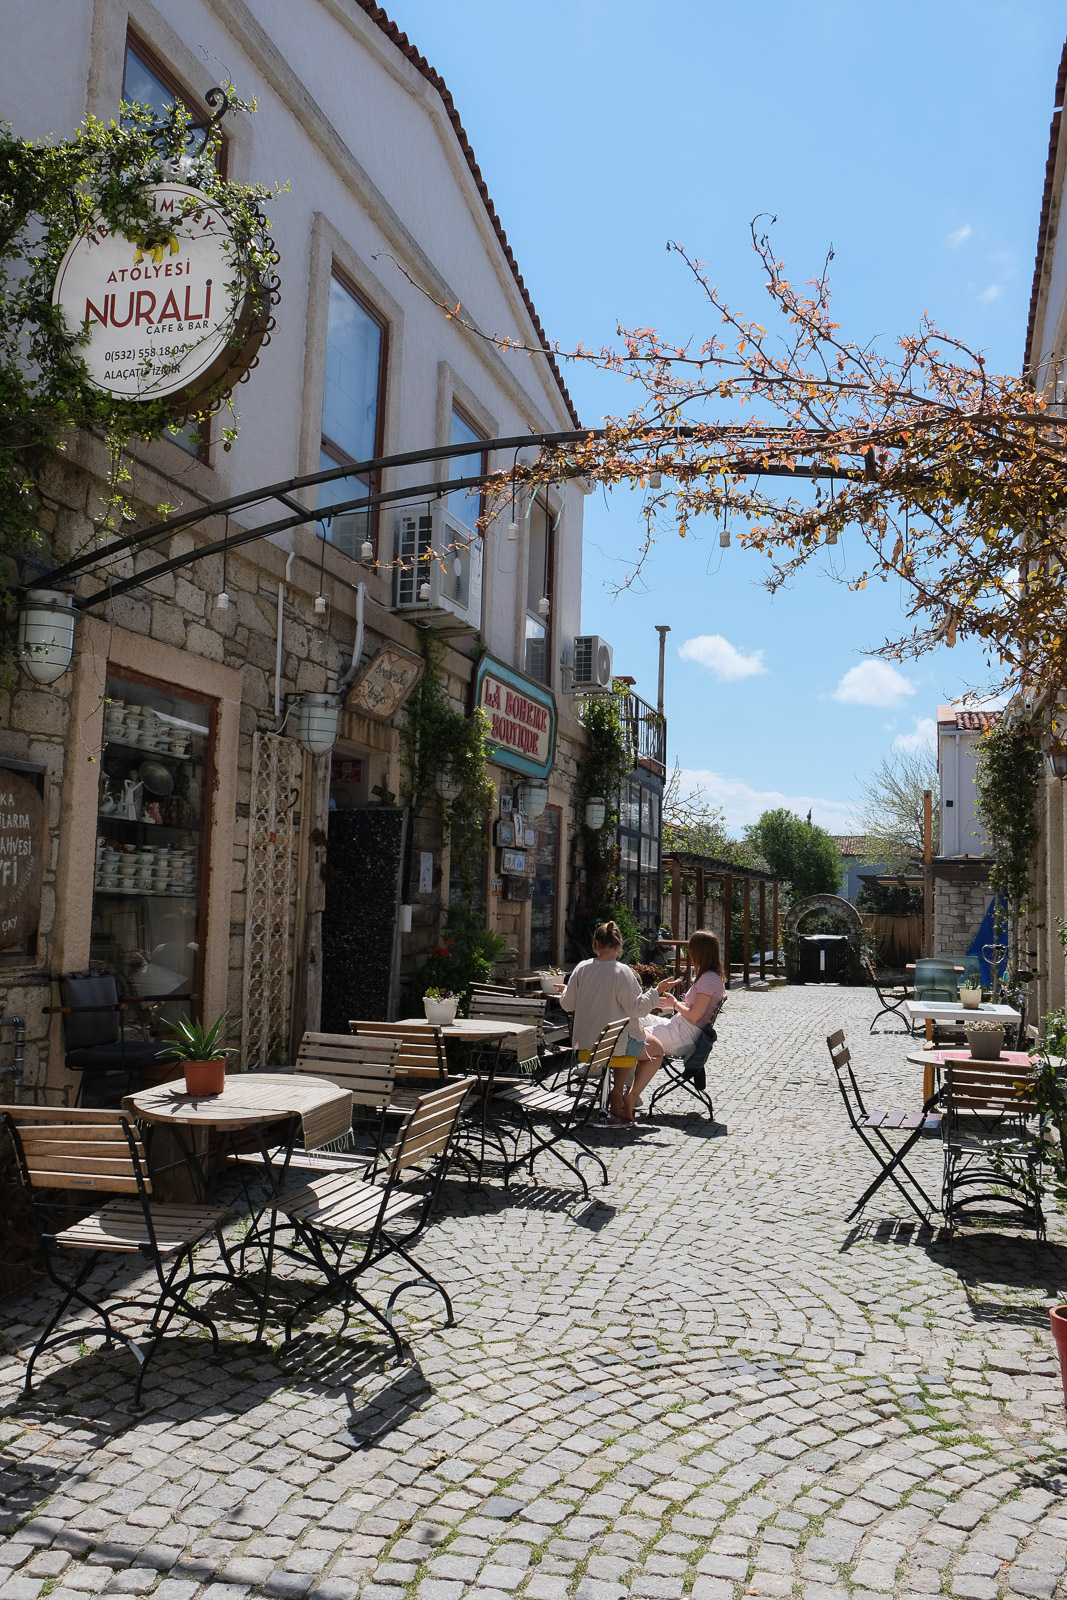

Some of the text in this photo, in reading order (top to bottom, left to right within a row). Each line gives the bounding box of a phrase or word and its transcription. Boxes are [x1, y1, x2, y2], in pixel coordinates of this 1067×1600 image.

[107, 258, 190, 284] ATÖLYESİ
[85, 279, 212, 330] NURALİ
[146, 320, 209, 335] CAFE & BAR
[104, 348, 136, 362] 0(532)
[138, 347, 156, 358] 558
[159, 346, 171, 356] 18
[484, 679, 548, 733] LA BOHEME
[491, 713, 540, 755] BOUTIQUE
[2, 916, 18, 936] ÇAY
